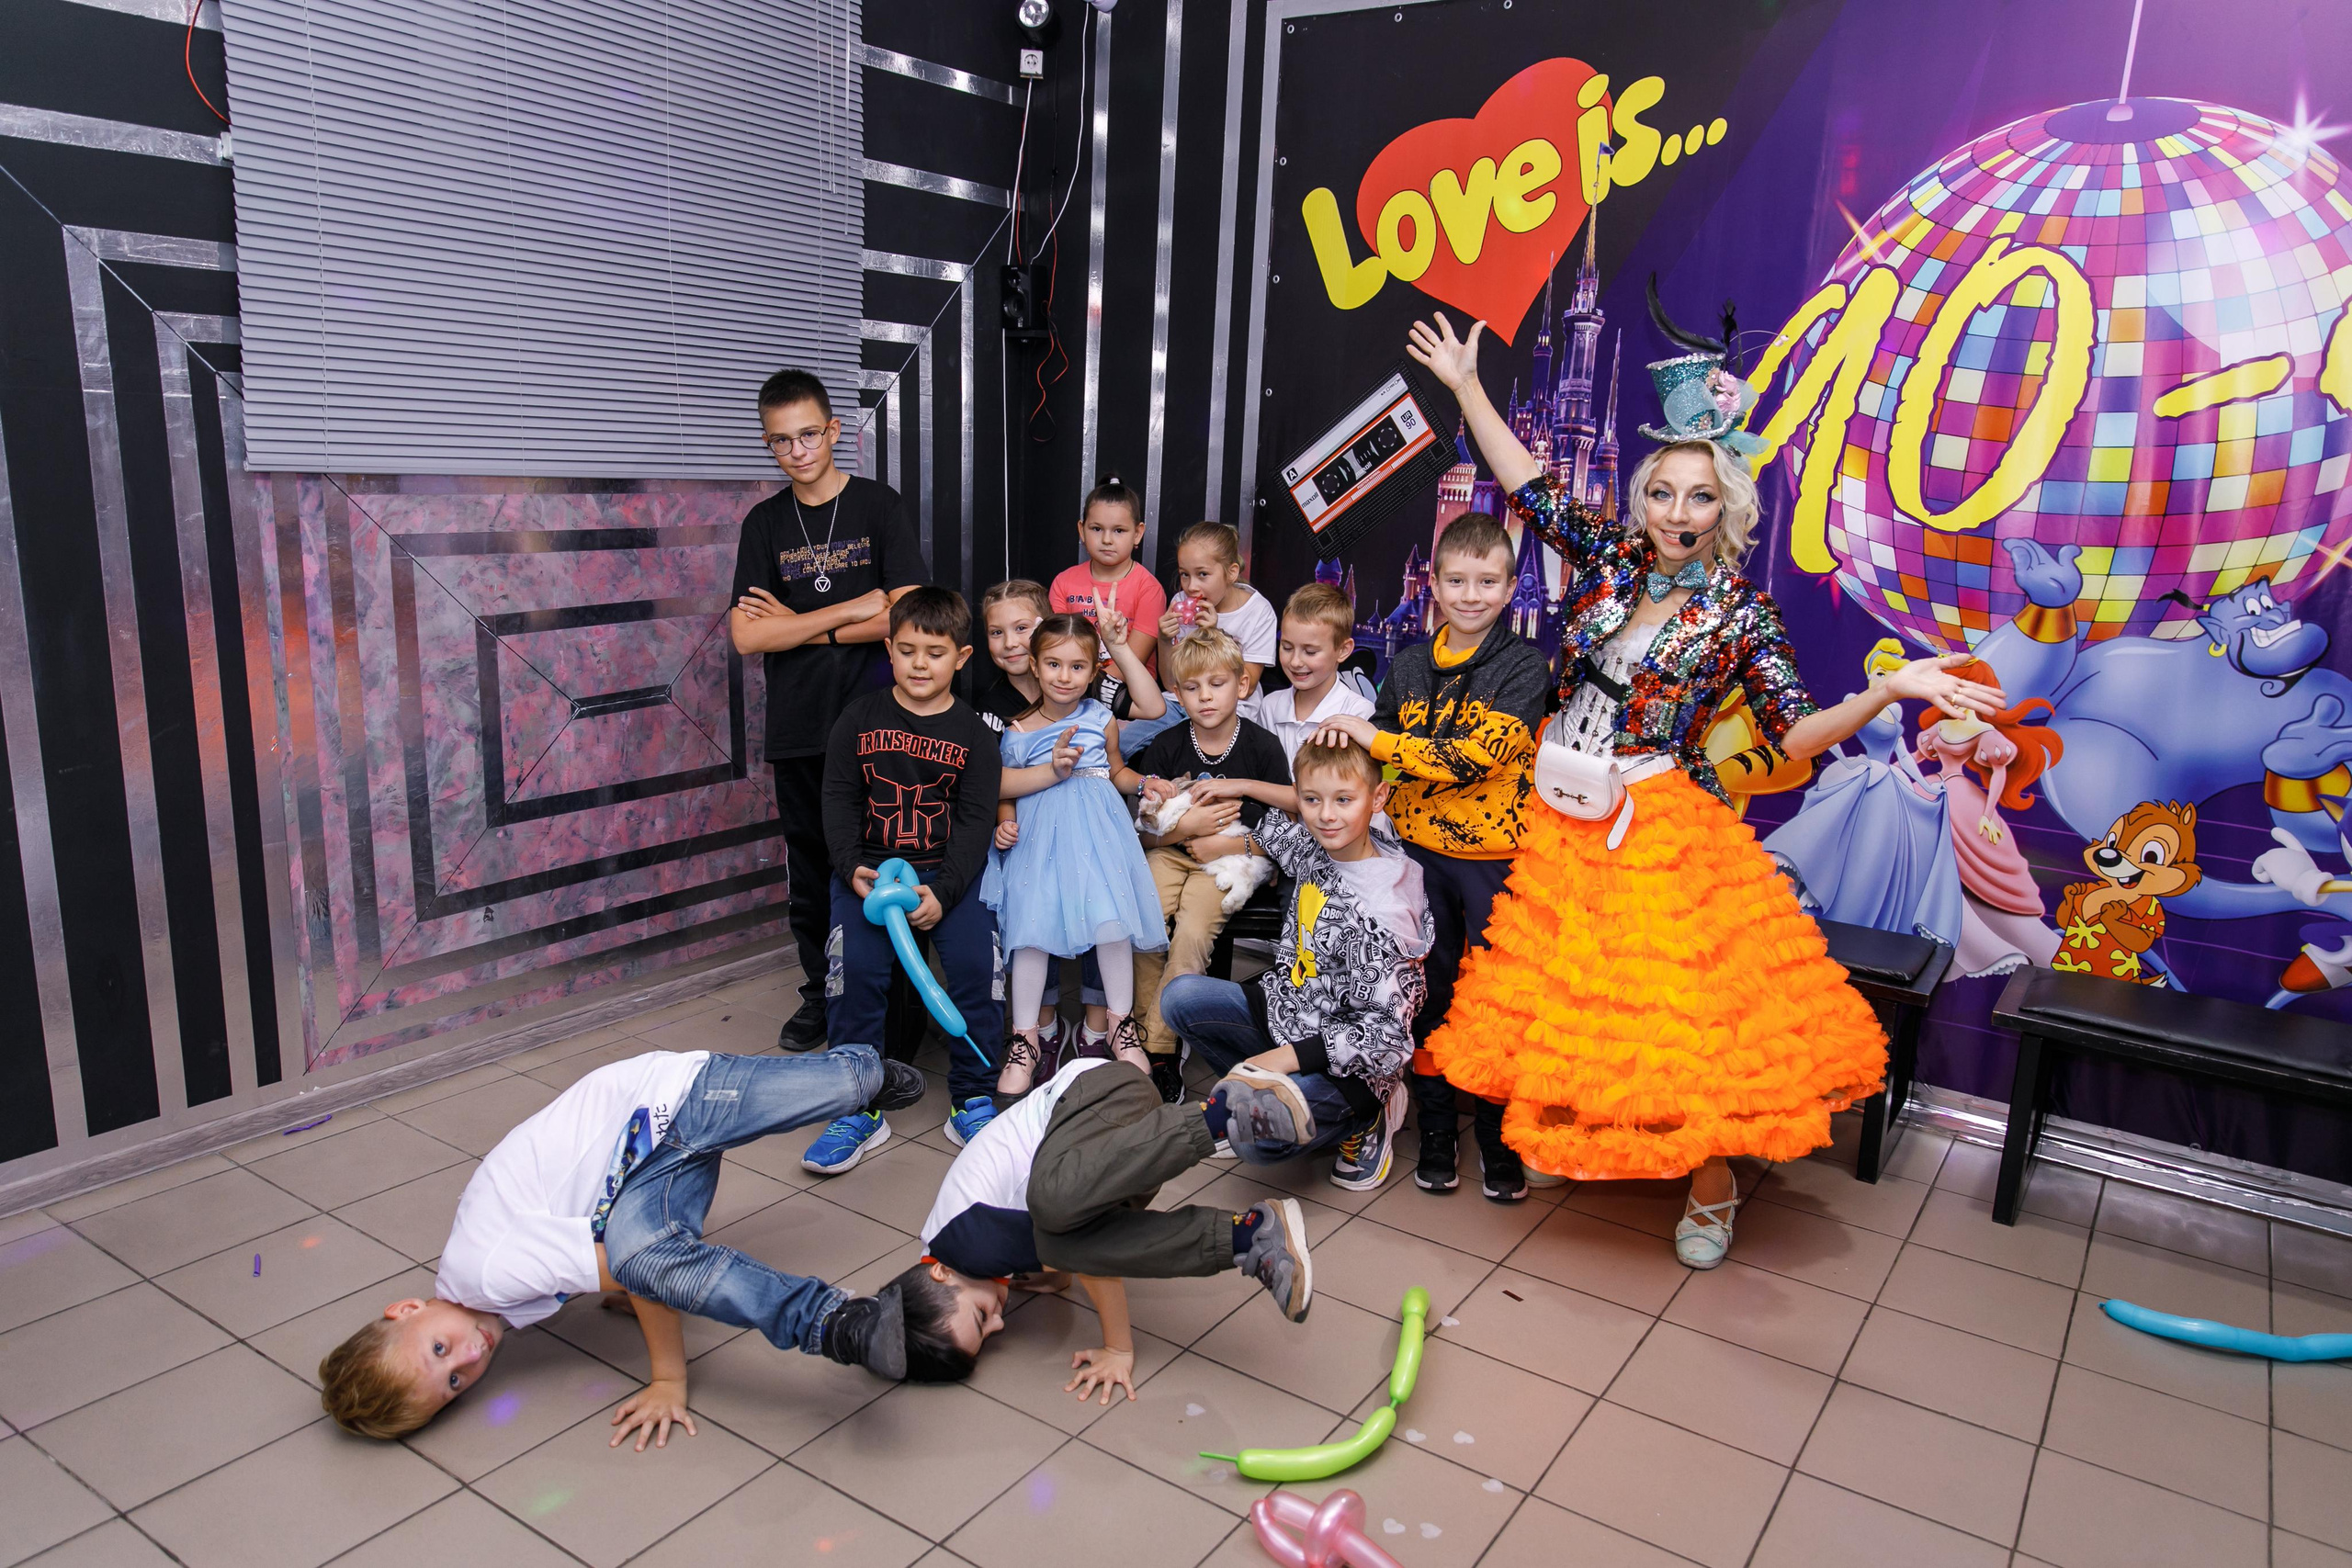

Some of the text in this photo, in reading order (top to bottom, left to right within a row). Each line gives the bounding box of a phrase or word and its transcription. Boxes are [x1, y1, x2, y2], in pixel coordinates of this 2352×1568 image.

[1302, 139, 1562, 310] Love
[1401, 411, 1412, 422] UR
[1405, 418, 1417, 430] 90
[1288, 468, 1298, 480] A
[856, 728, 970, 770] TRANSFORMERS
